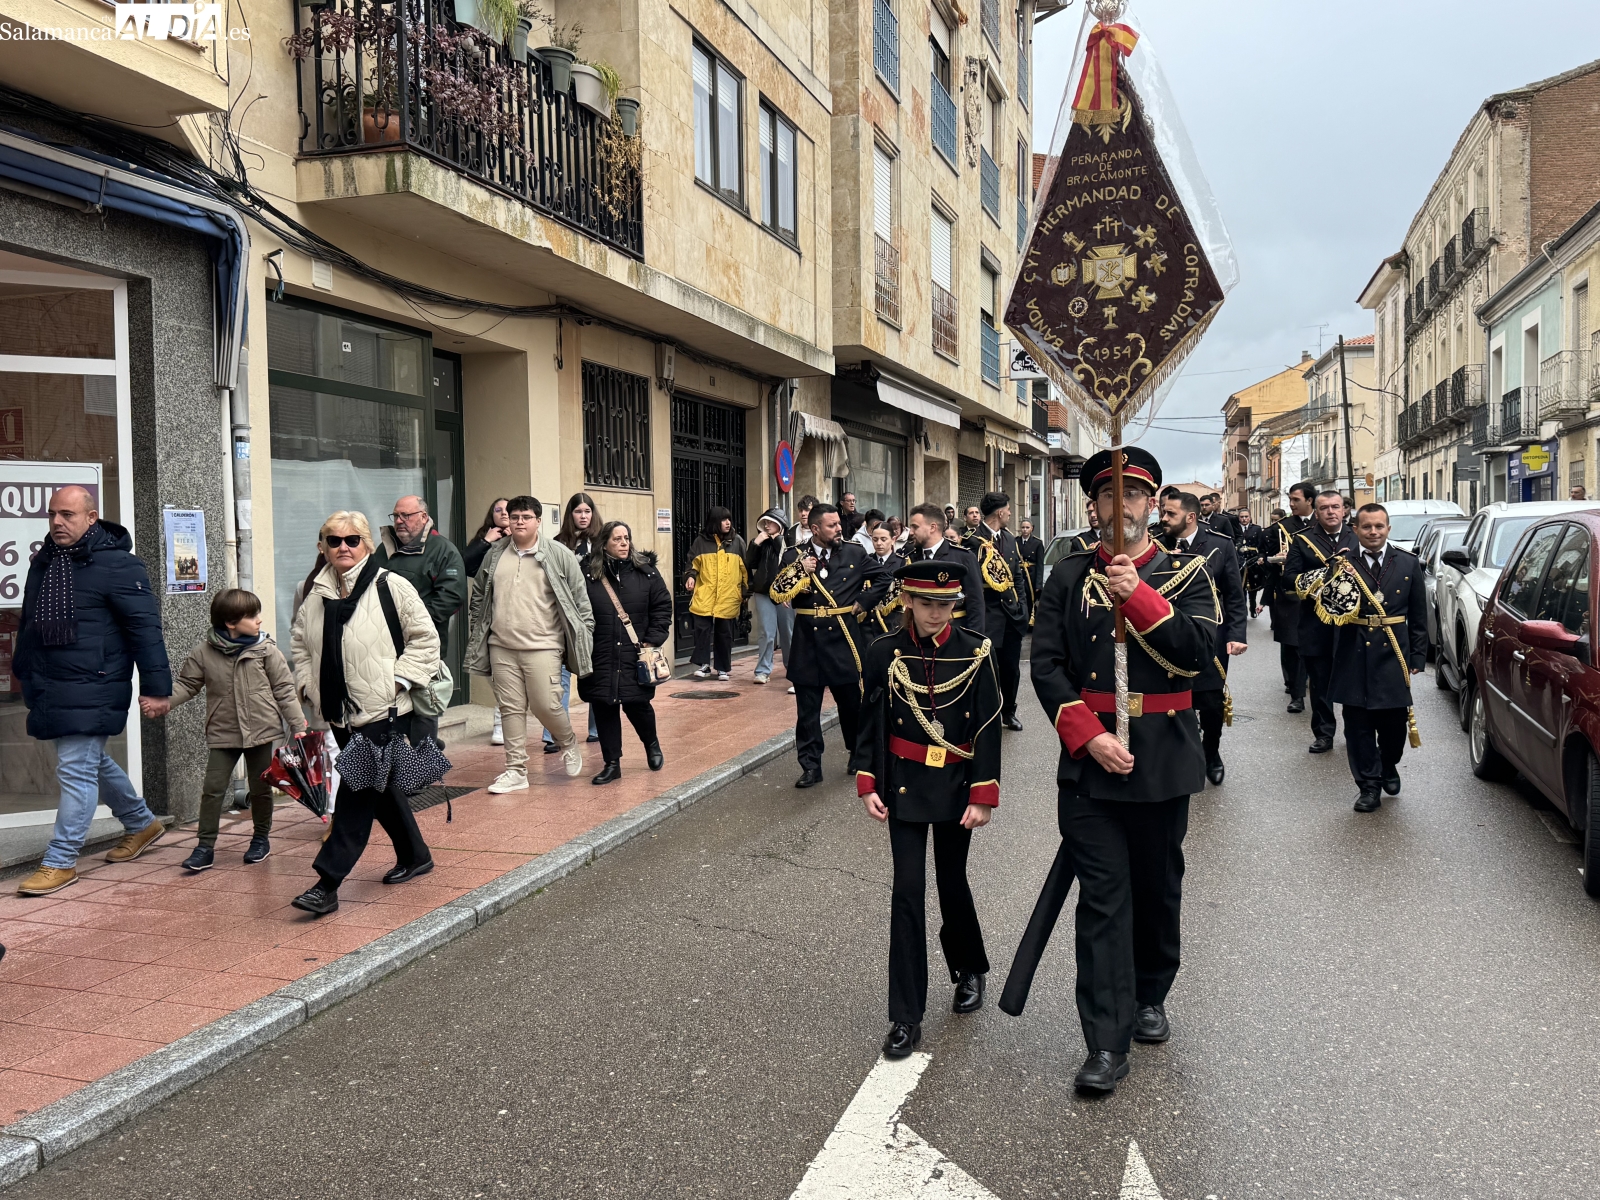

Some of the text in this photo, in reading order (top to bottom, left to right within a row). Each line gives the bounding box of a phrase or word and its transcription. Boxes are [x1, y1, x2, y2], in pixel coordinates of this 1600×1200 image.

[1071, 148, 1143, 166] PEÑARANDA
[1099, 161, 1113, 172] DE
[1066, 165, 1148, 186] BRACAMONTE
[1039, 185, 1142, 236] HERMANDAD
[1155, 194, 1181, 219] DE
[1159, 243, 1200, 341] COFRADÍAS
[1026, 297, 1065, 351] BANDA
[1093, 345, 1132, 361] 1954
[0, 486, 62, 517] QUI
